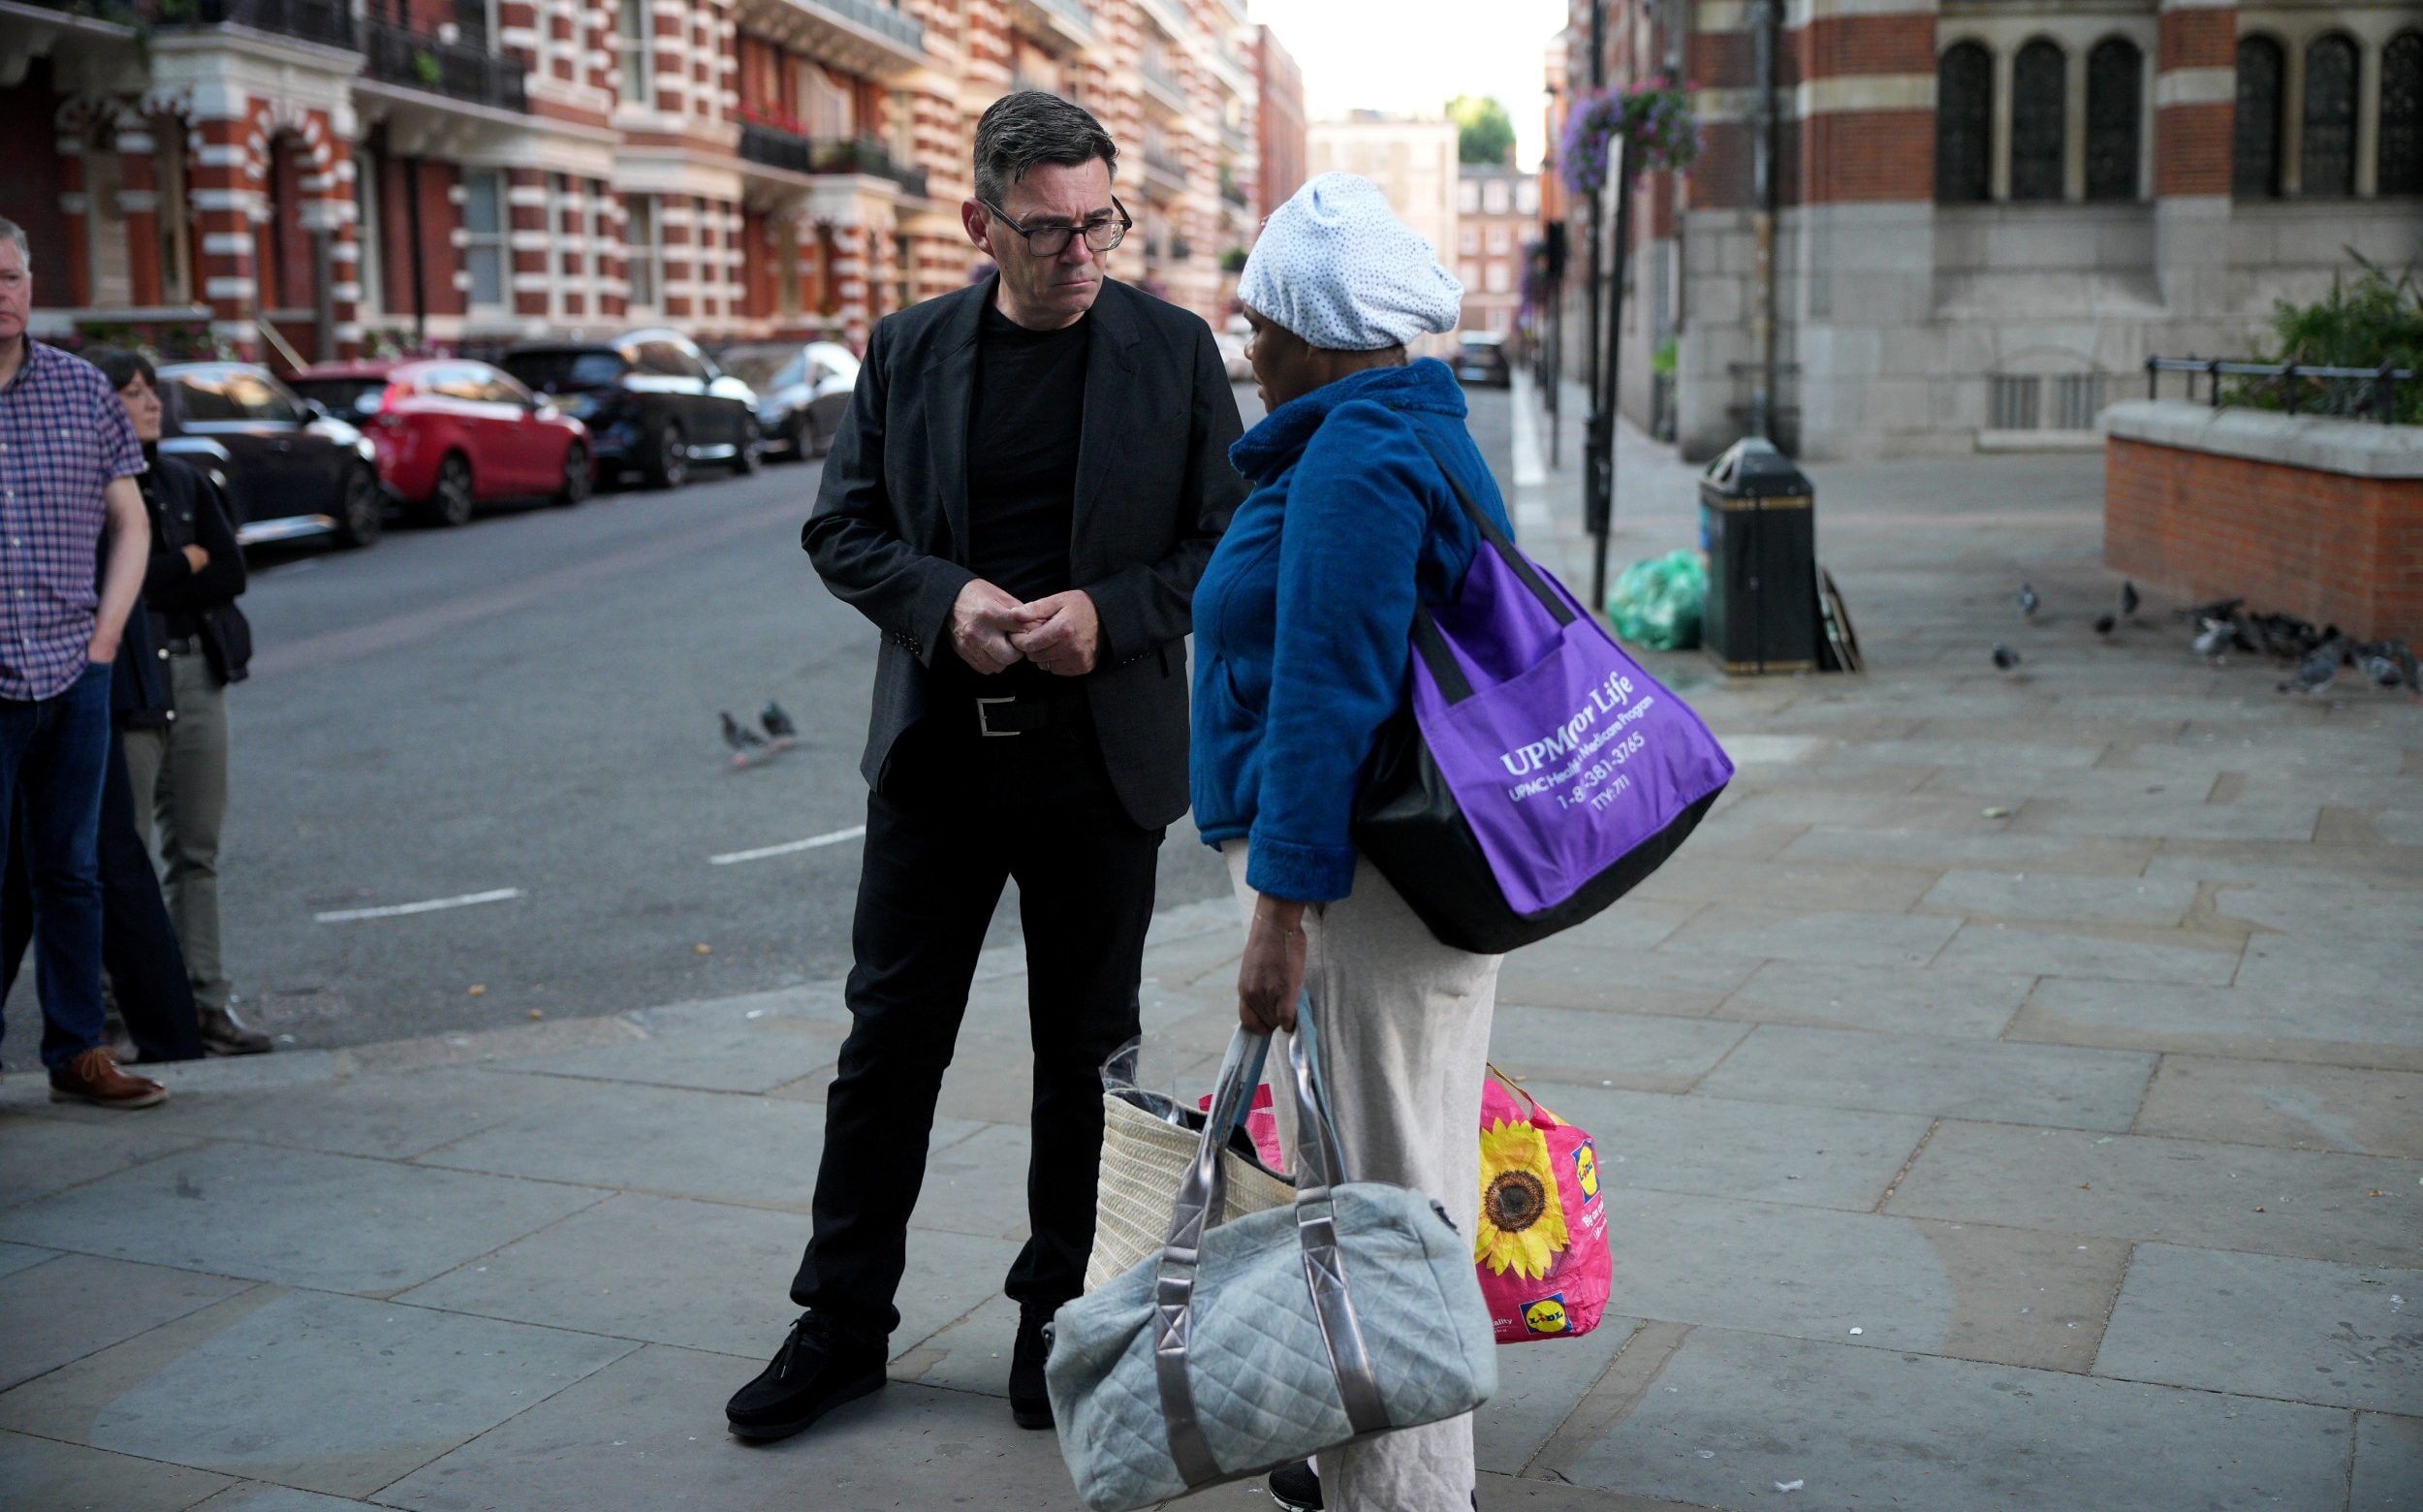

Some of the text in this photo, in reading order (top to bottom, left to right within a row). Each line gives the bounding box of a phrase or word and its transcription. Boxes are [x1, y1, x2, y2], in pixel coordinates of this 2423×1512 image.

[1499, 724, 1577, 775] UPM
[1589, 671, 1634, 713] Life
[1508, 776, 1549, 803] UPMC
[1578, 721, 1623, 759] Medicare
[1492, 1317, 1513, 1326] ality
